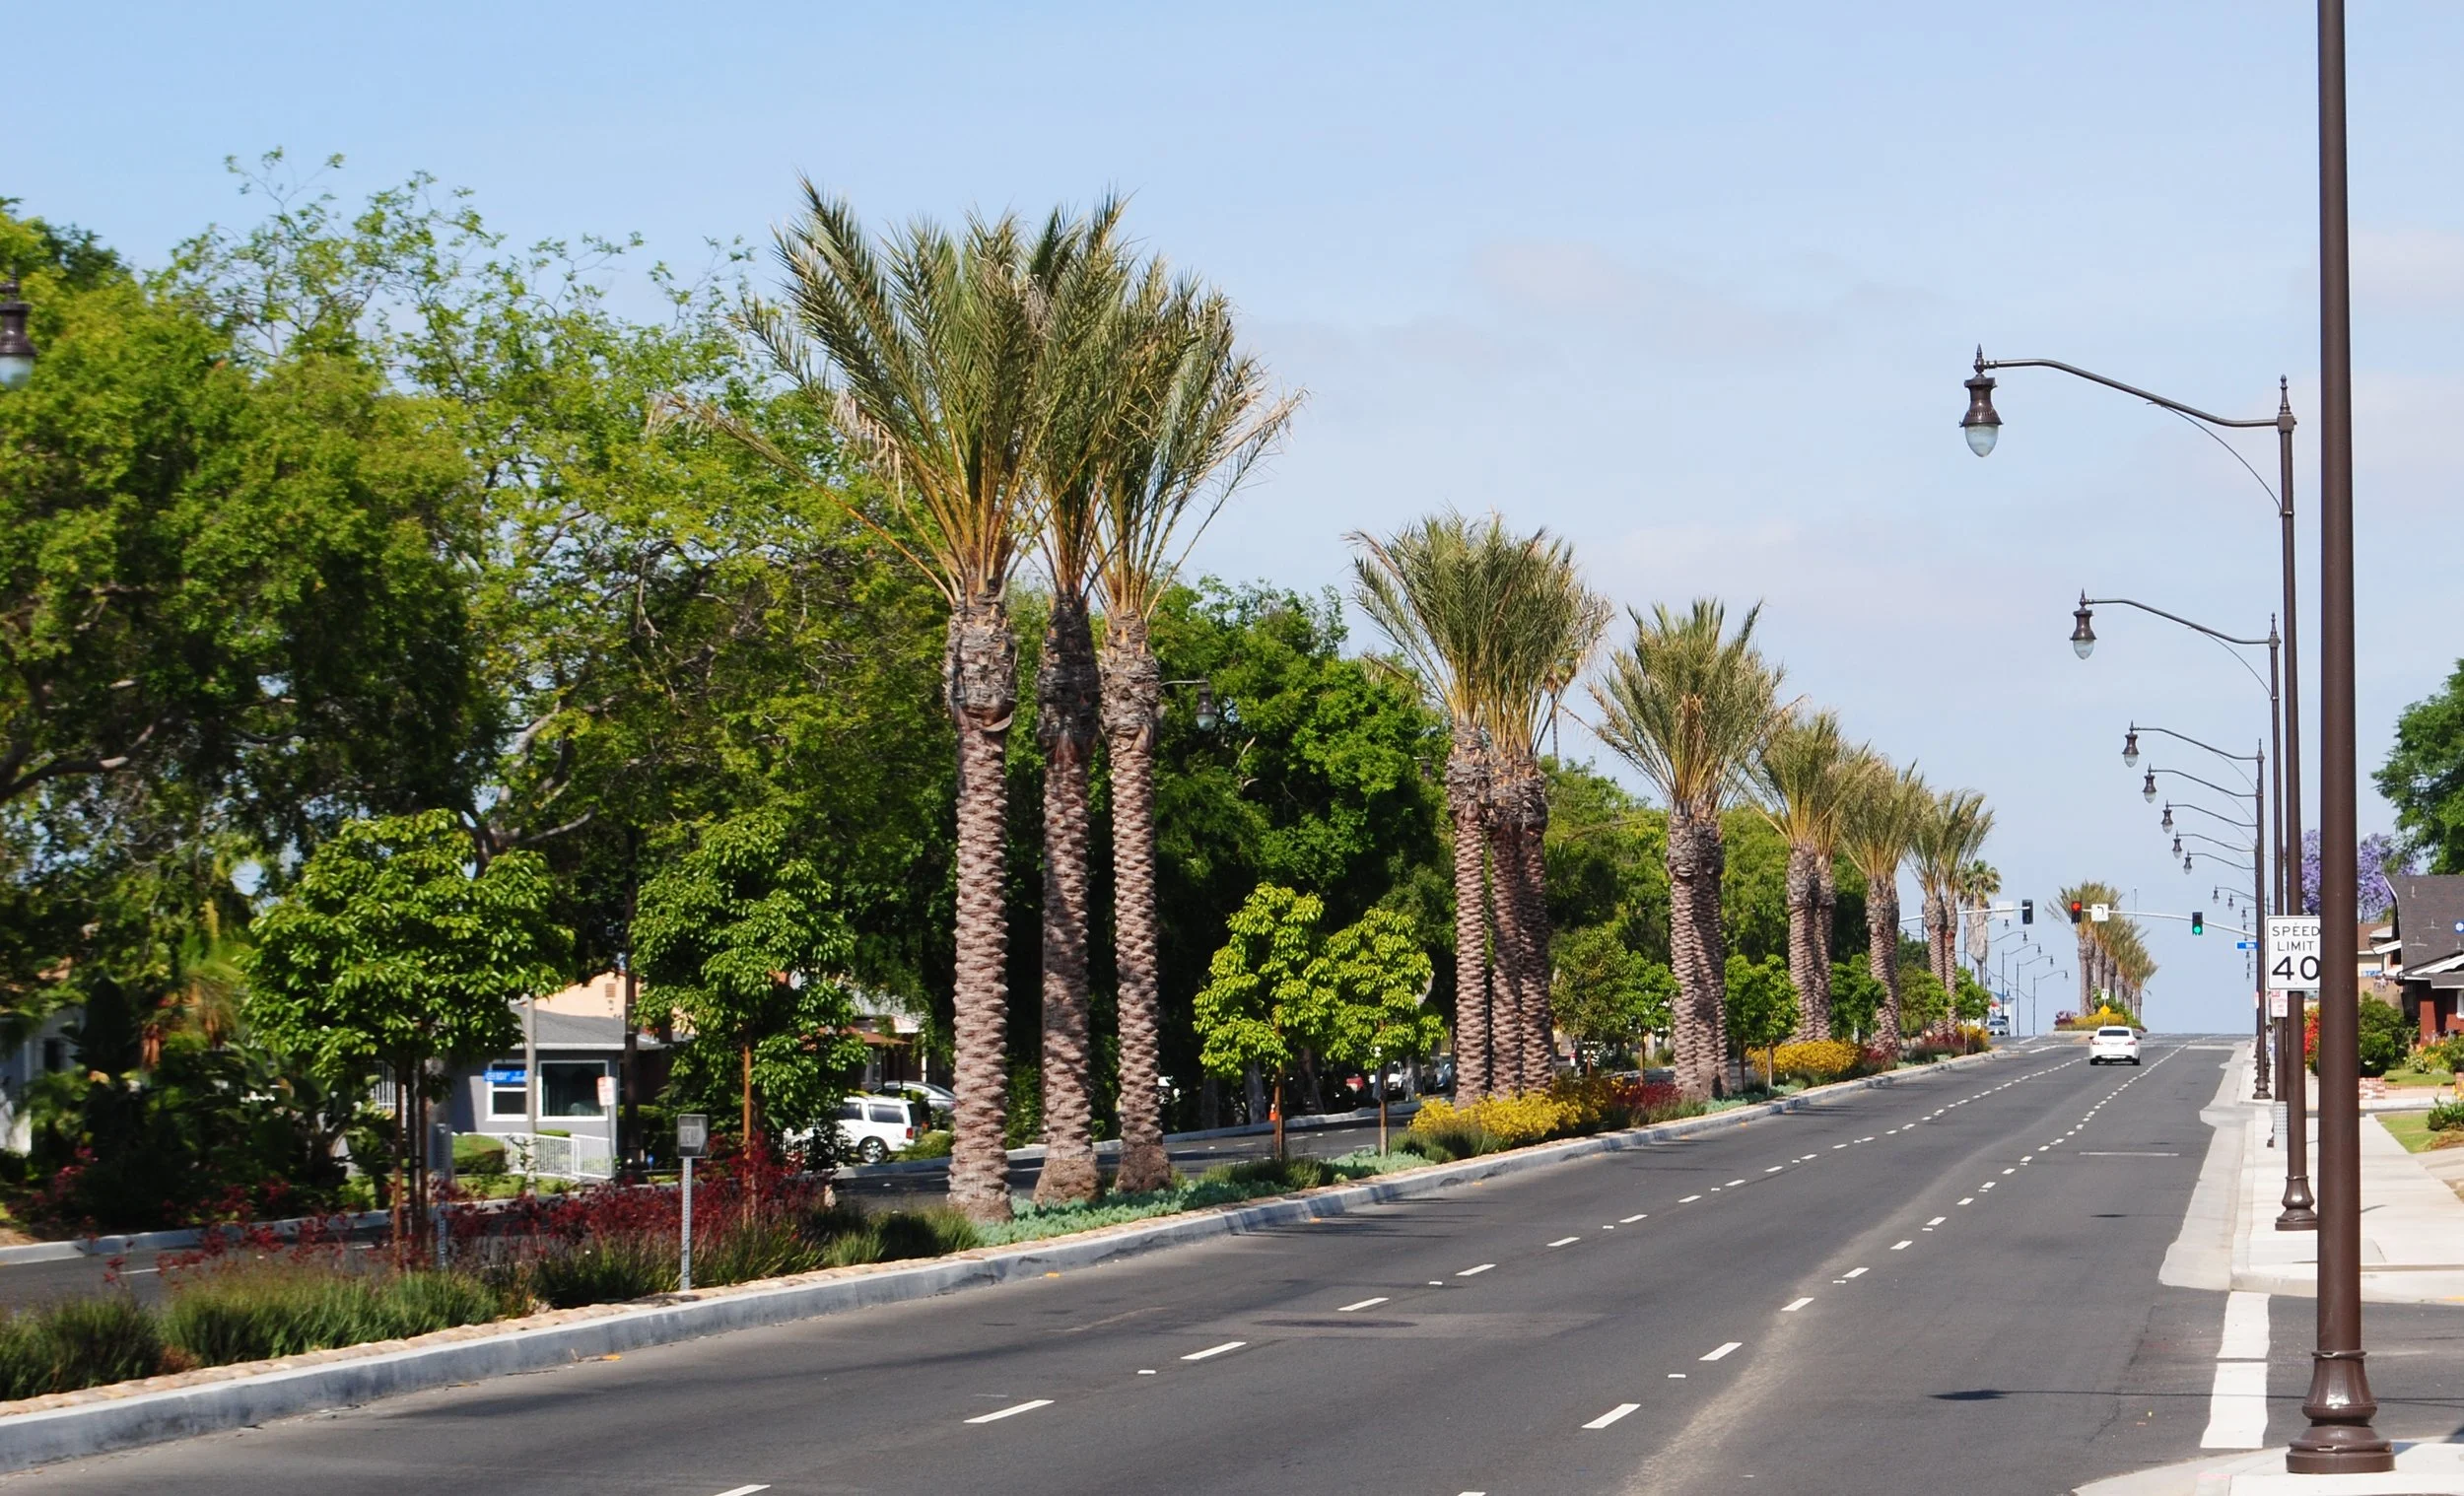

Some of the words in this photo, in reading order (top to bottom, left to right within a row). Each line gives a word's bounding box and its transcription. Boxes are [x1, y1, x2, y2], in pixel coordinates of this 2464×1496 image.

[2272, 926, 2320, 936] SPEED
[2277, 941, 2314, 951] LIMIT
[2272, 956, 2320, 981] 40
